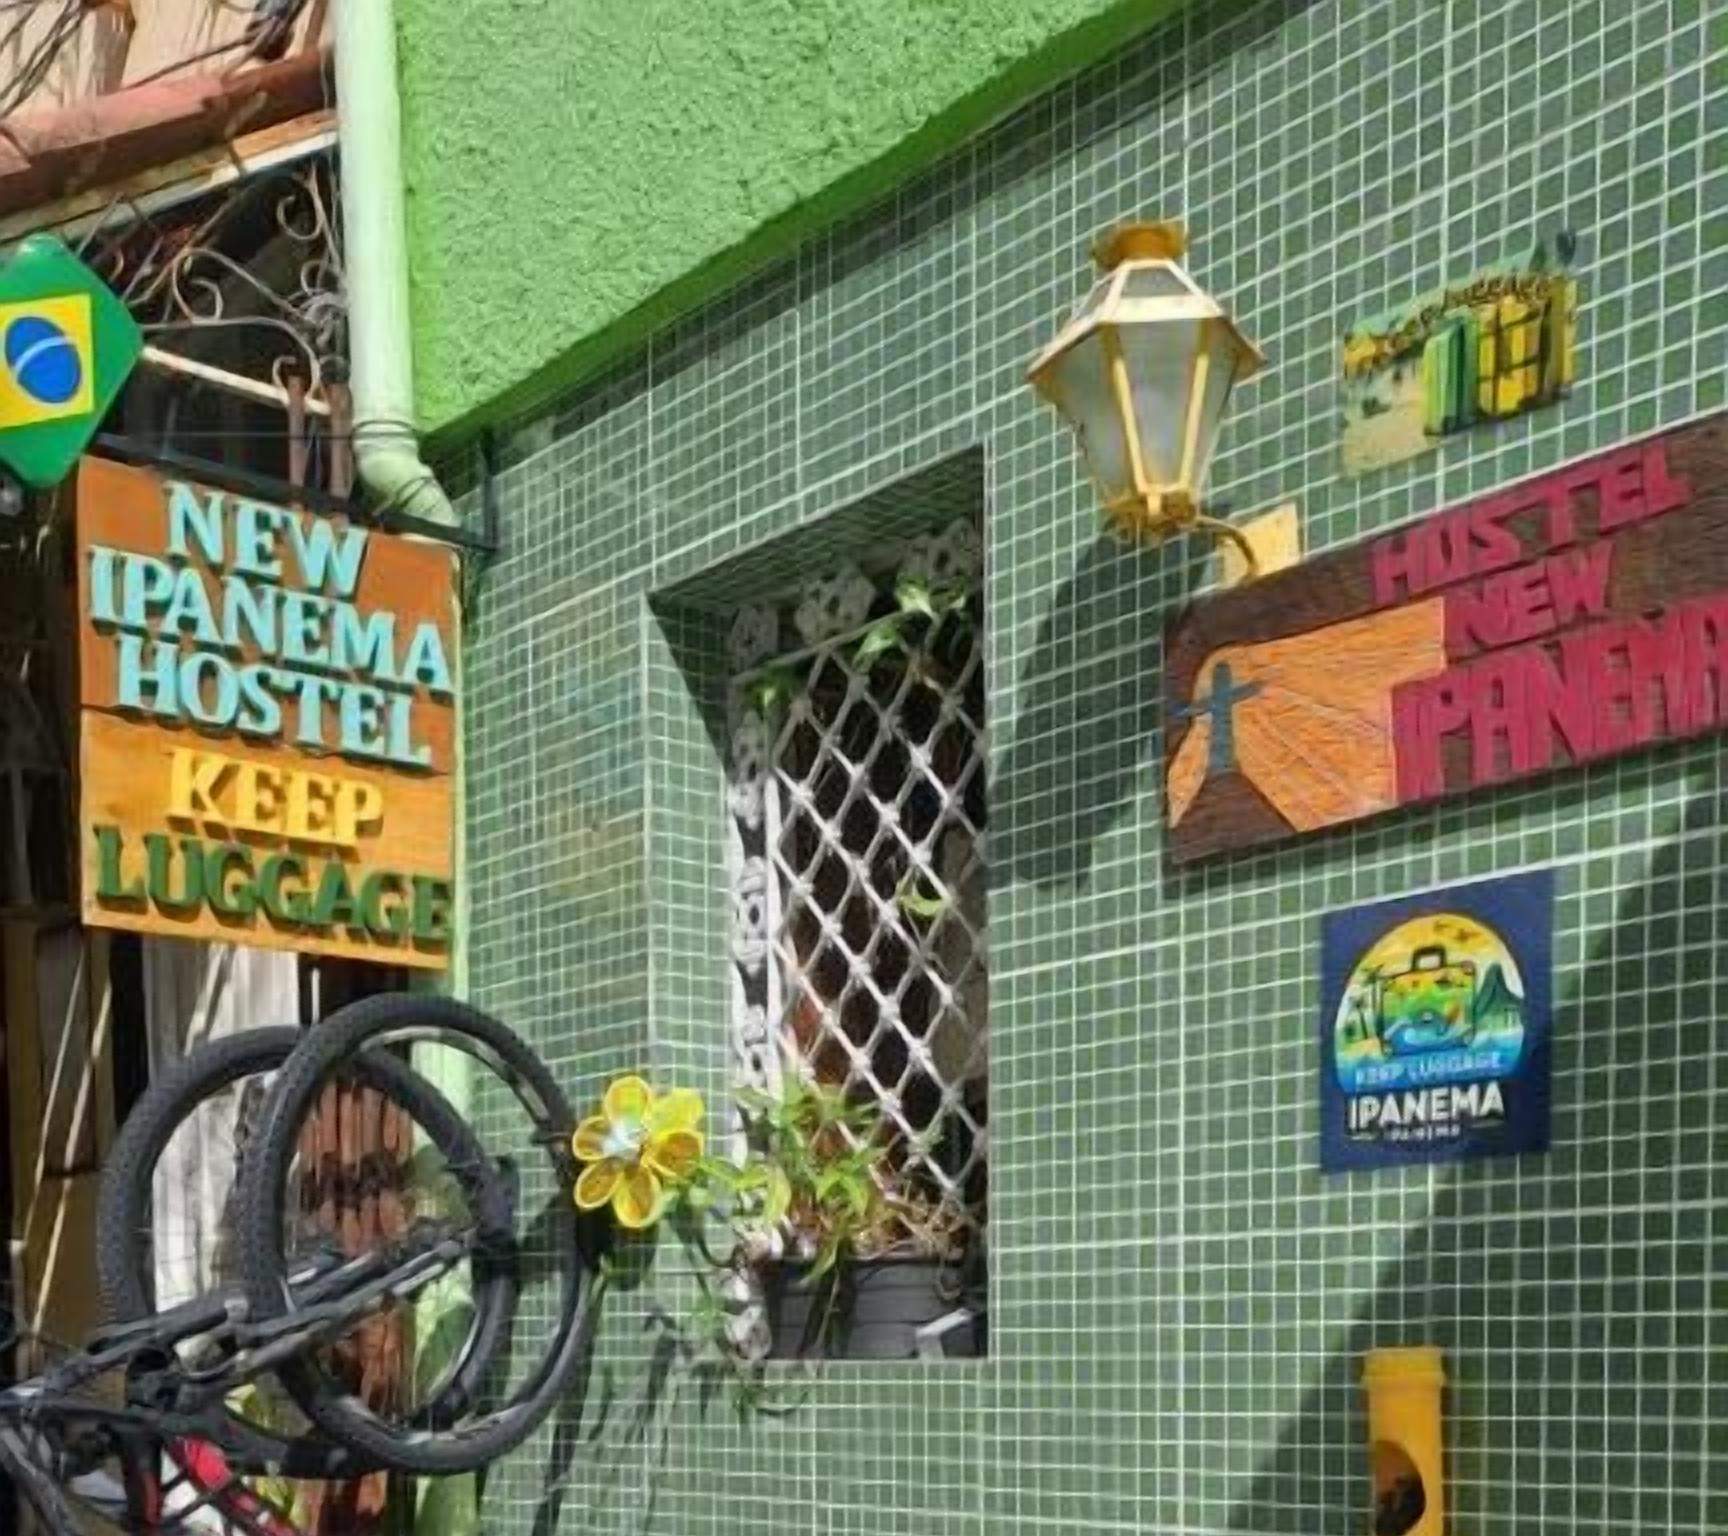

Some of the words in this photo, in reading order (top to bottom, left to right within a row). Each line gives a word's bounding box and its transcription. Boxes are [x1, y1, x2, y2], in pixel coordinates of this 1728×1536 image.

[165, 480, 366, 596] NEW
[1373, 438, 1692, 605] HOSTEL
[90, 544, 451, 697] IPANEMA
[1443, 538, 1614, 664] NEW
[119, 634, 432, 766] HOSTEL
[1391, 588, 1728, 803] IPANEMA
[166, 745, 383, 845] KEEP
[94, 824, 454, 940] LUGGAGE
[1349, 1080, 1504, 1129] IPANEMA
